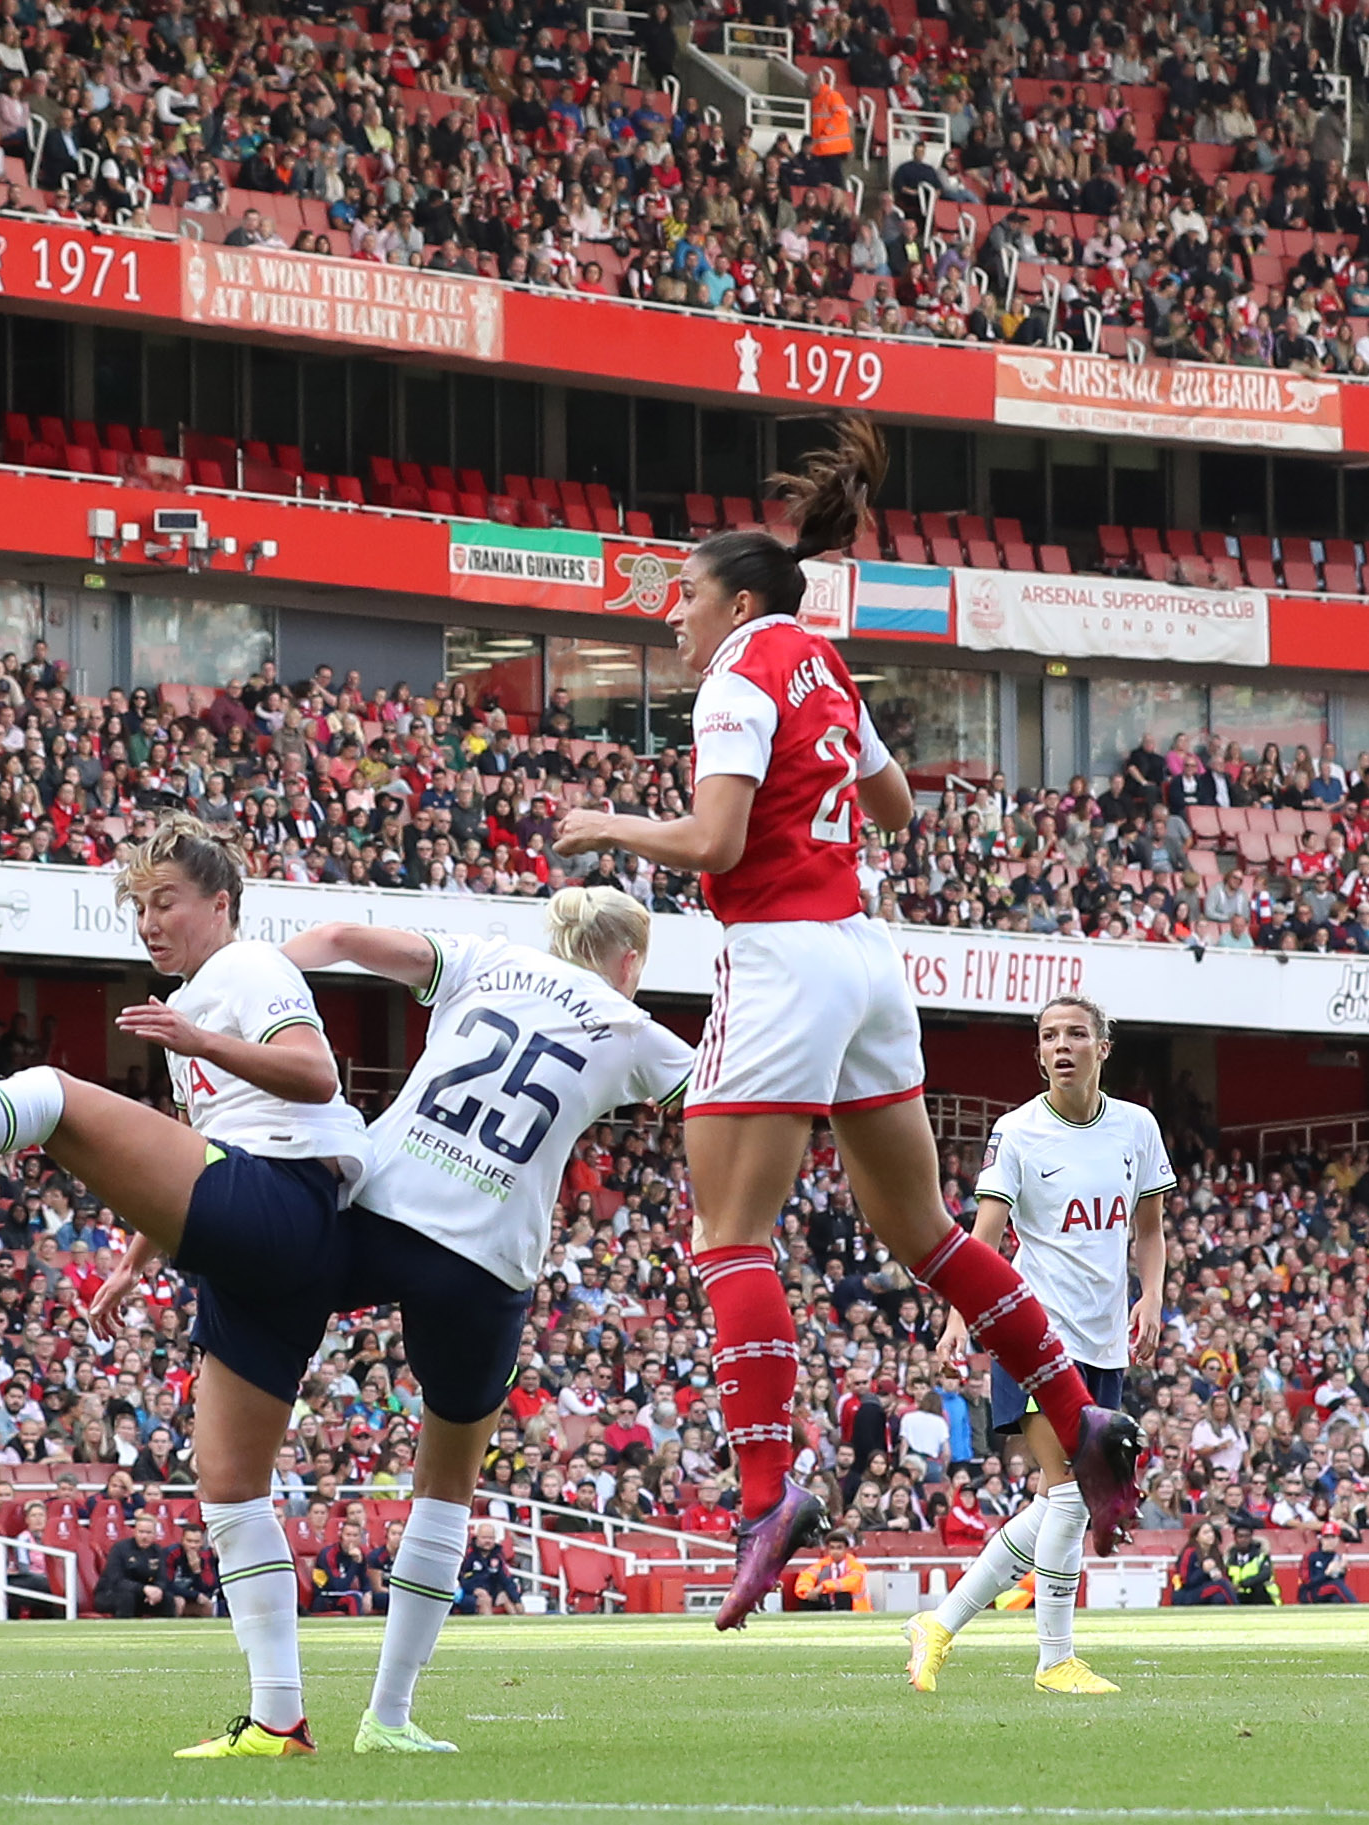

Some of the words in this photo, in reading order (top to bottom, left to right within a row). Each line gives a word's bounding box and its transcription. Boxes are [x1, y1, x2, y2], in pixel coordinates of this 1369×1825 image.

[32, 237, 141, 302] 1971
[215, 250, 253, 285] WE
[257, 257, 312, 294] WON
[318, 265, 368, 300] THE
[374, 273, 465, 314] LEAGUE
[211, 286, 246, 320] AT
[250, 291, 329, 331] WHITE
[335, 302, 401, 340] HART
[407, 312, 468, 348] LANE
[783, 342, 882, 401] 1979
[1059, 358, 1163, 404] ARSENAL
[1171, 369, 1282, 413] BULGARIA
[468, 545, 523, 575] IRANIAN
[527, 554, 584, 581] GUNNERS
[1021, 585, 1098, 608] ARSENAL
[1102, 590, 1209, 617] SUPPORTERS
[1214, 601, 1255, 619] CLUB
[705, 711, 732, 722] VISIT
[811, 725, 858, 844] 2
[476, 970, 613, 1043] SUMMANEN
[963, 949, 999, 1000] FLY
[1005, 952, 1082, 1003] BETTER
[416, 1007, 588, 1165] 25
[400, 1139, 509, 1204] NUTRITION
[407, 1125, 517, 1190] HERBALIFE
[1061, 1195, 1128, 1233] AIA
